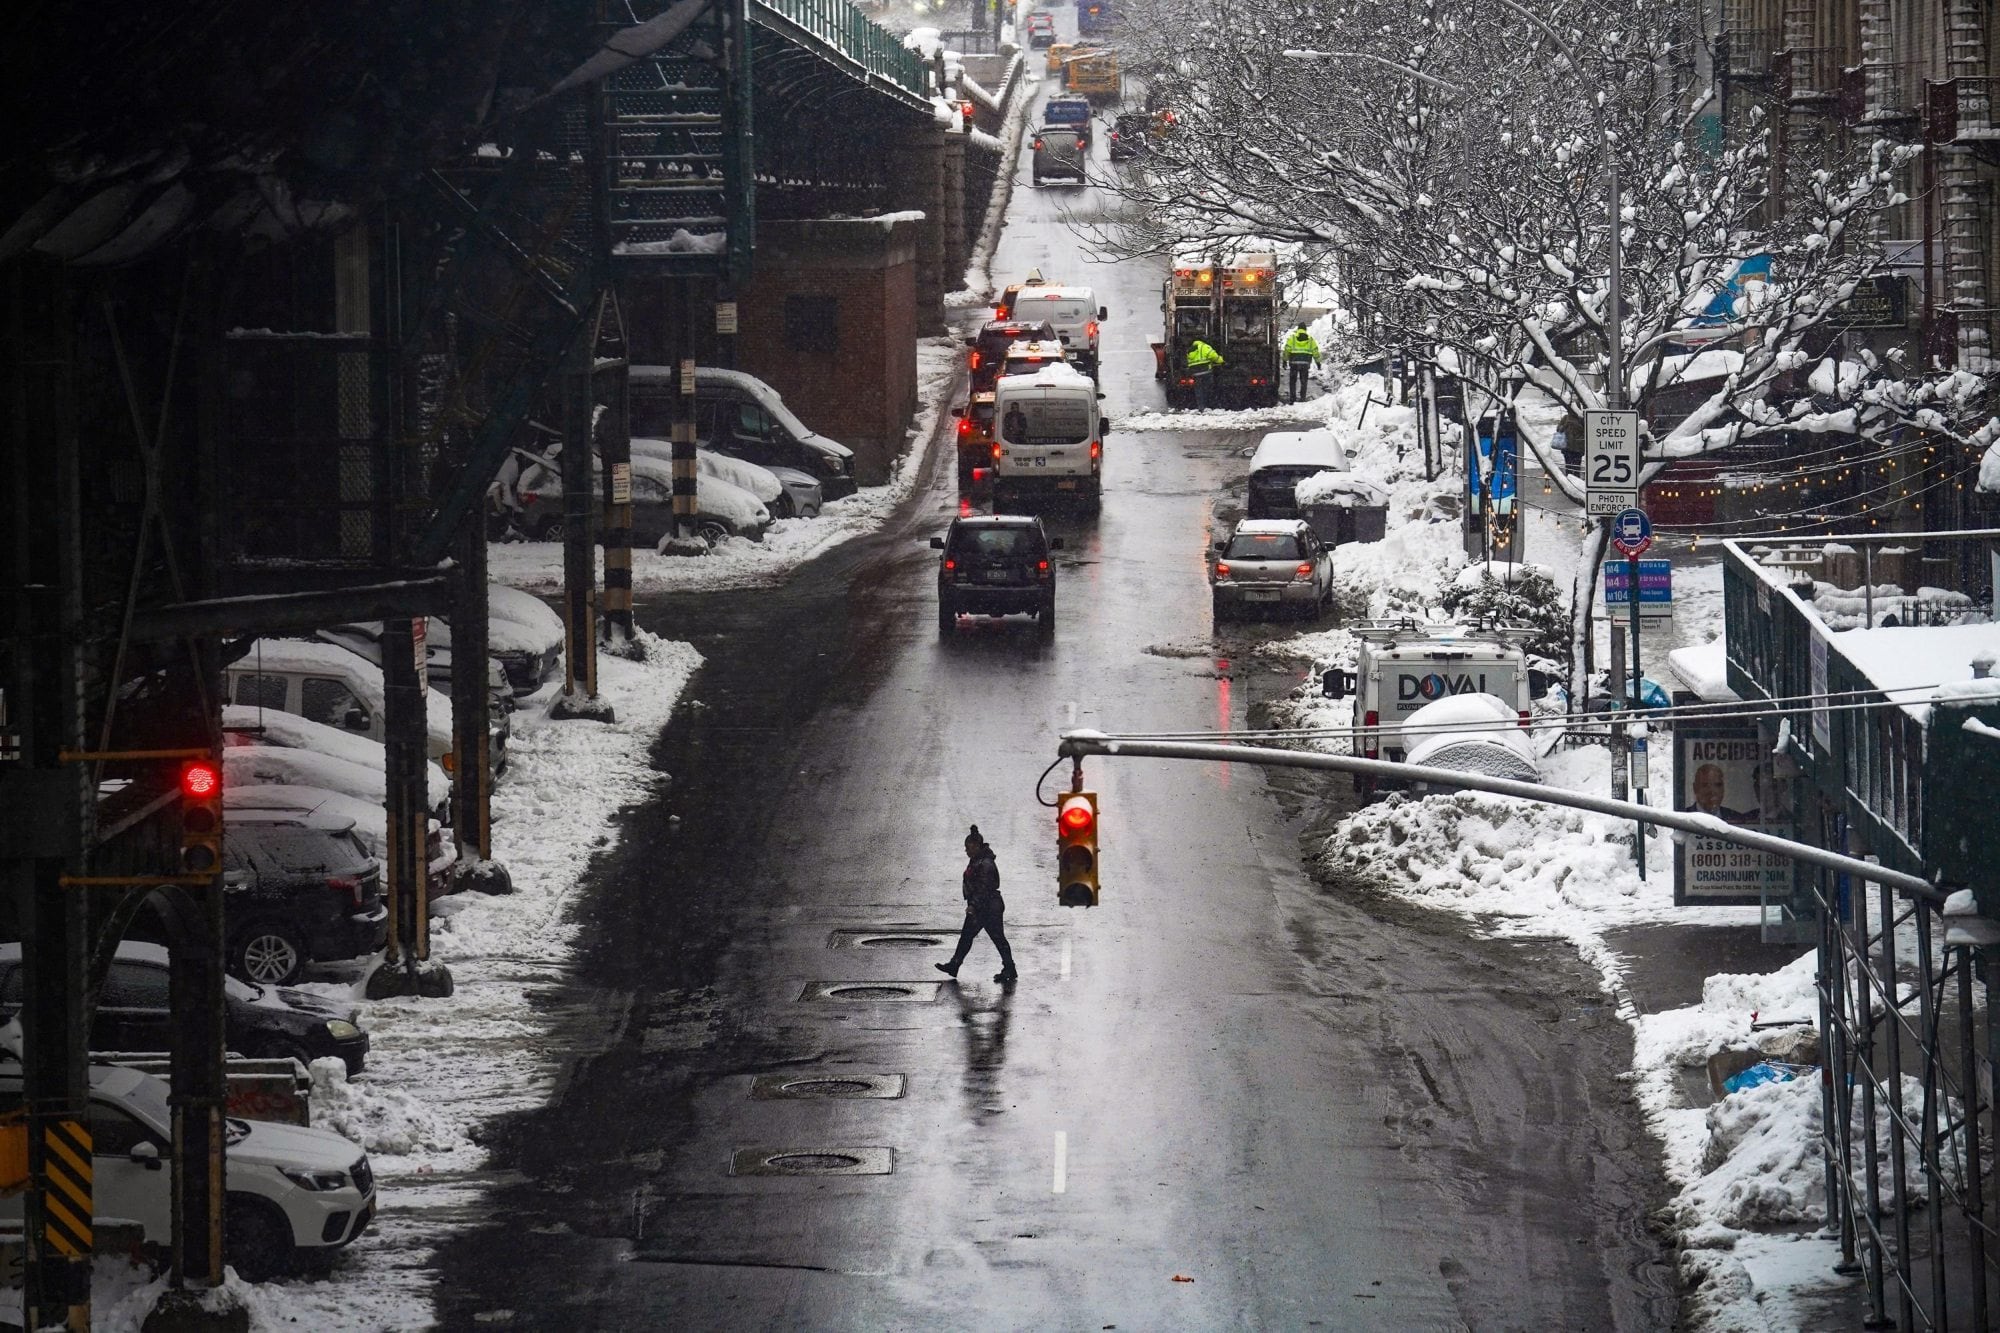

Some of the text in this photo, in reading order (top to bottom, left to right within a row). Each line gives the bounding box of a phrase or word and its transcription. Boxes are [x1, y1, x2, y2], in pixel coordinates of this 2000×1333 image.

[1600, 417, 1622, 425] CITY
[1596, 428, 1626, 438] SPEED
[1599, 441, 1623, 450] LIMIT
[1593, 454, 1632, 483] 25
[1598, 495, 1625, 503] PHOTO
[1606, 564, 1620, 574] M4
[1606, 577, 1620, 587] M4
[1607, 590, 1628, 601] M104
[1398, 673, 1499, 700] DOVAL
[1692, 742, 1772, 760] ACCIDEN
[1691, 853, 1726, 868] (800)
[1696, 870, 1785, 882] CRASHINJURYCOM
